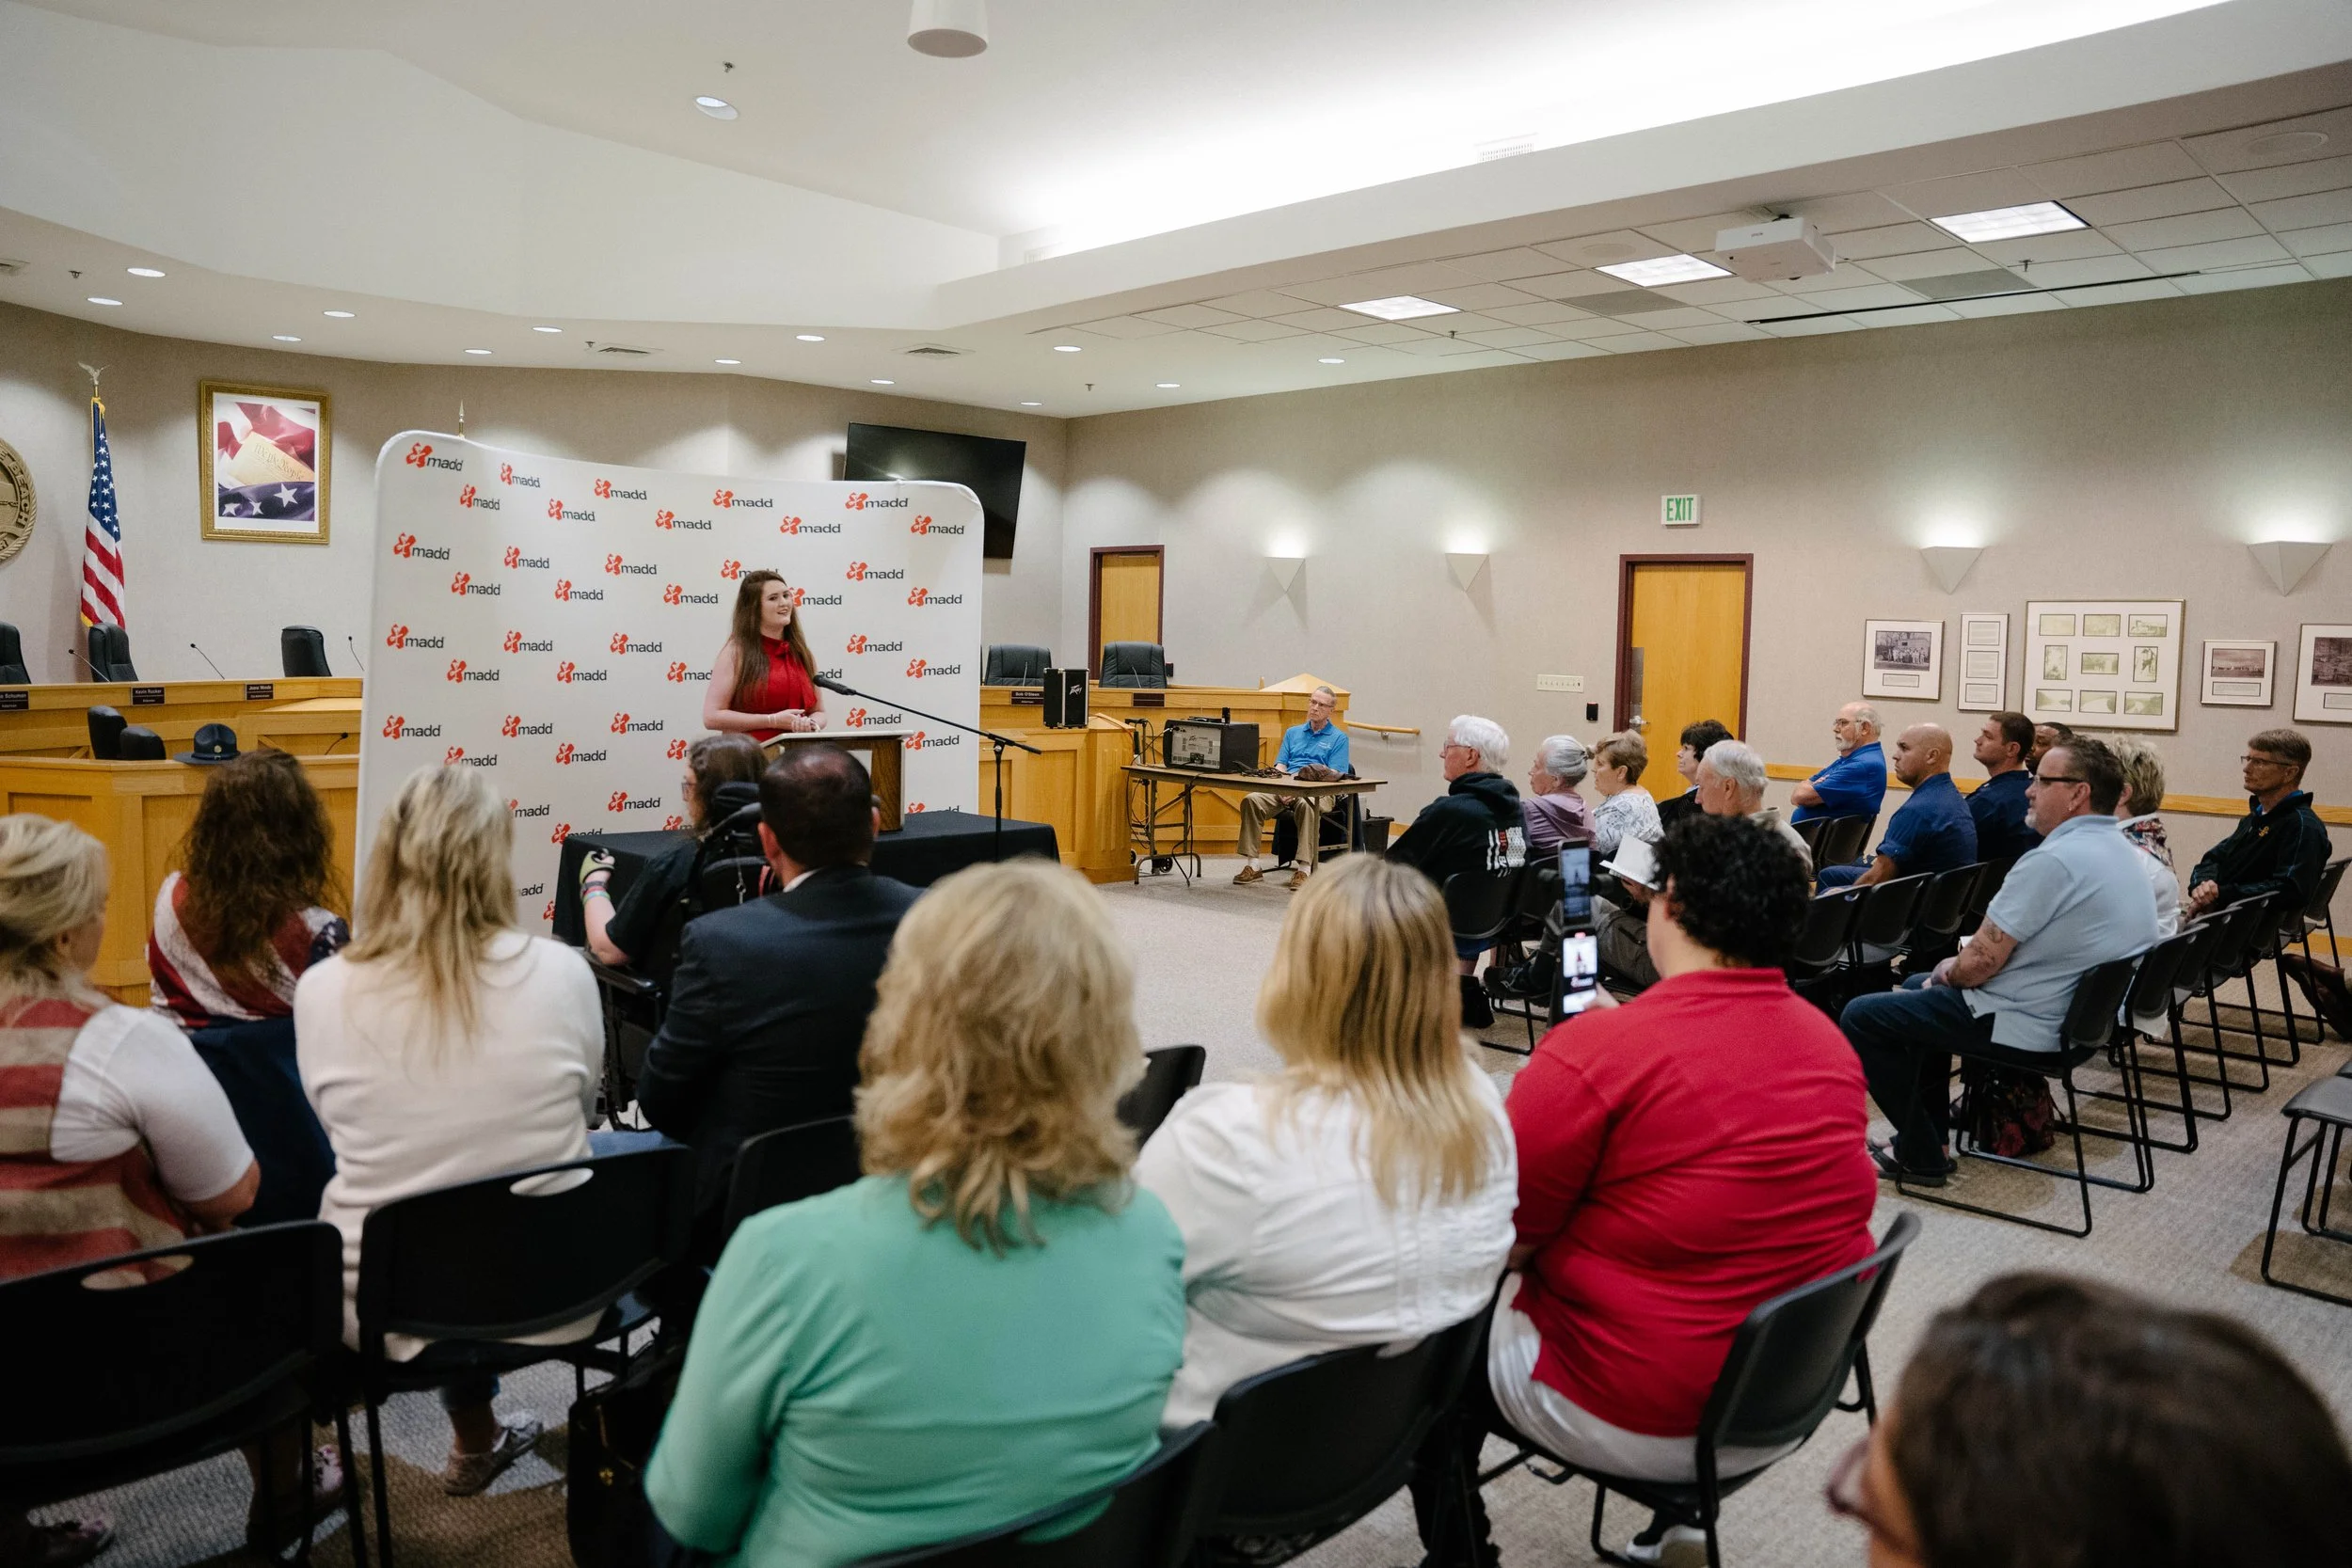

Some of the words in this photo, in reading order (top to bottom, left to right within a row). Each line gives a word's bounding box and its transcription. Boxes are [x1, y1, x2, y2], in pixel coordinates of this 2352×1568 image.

[426, 457, 464, 472] madd
[512, 475, 541, 488] madd
[610, 489, 647, 500] madd
[472, 498, 501, 511] madd
[731, 498, 773, 508] madd
[865, 498, 909, 508] madd
[1666, 498, 1694, 521] EXIT
[562, 510, 596, 522] madd
[672, 519, 712, 531] madd
[799, 523, 841, 534] madd
[928, 524, 965, 535] madd
[411, 546, 451, 561] madd
[517, 557, 550, 569] madd
[620, 563, 658, 576] madd
[865, 568, 904, 579] madd
[467, 583, 501, 596] madd
[569, 589, 604, 601] madd
[680, 593, 719, 605] madd
[802, 594, 842, 606] madd
[924, 594, 962, 605] madd
[405, 636, 445, 649] madd
[518, 640, 553, 652] madd
[626, 641, 662, 654] madd
[864, 641, 903, 653] madd
[463, 669, 500, 682] madd
[572, 669, 608, 682] madd
[684, 669, 713, 681] mad
[923, 664, 961, 676] madd
[863, 713, 902, 725] madd
[401, 724, 441, 737] madd
[517, 722, 553, 736] madd
[627, 720, 664, 732] madd
[922, 734, 961, 748] madd
[460, 753, 498, 768] madd
[571, 749, 607, 763] madd
[624, 797, 661, 810] madd
[514, 803, 550, 818] madd
[518, 882, 544, 896] add
